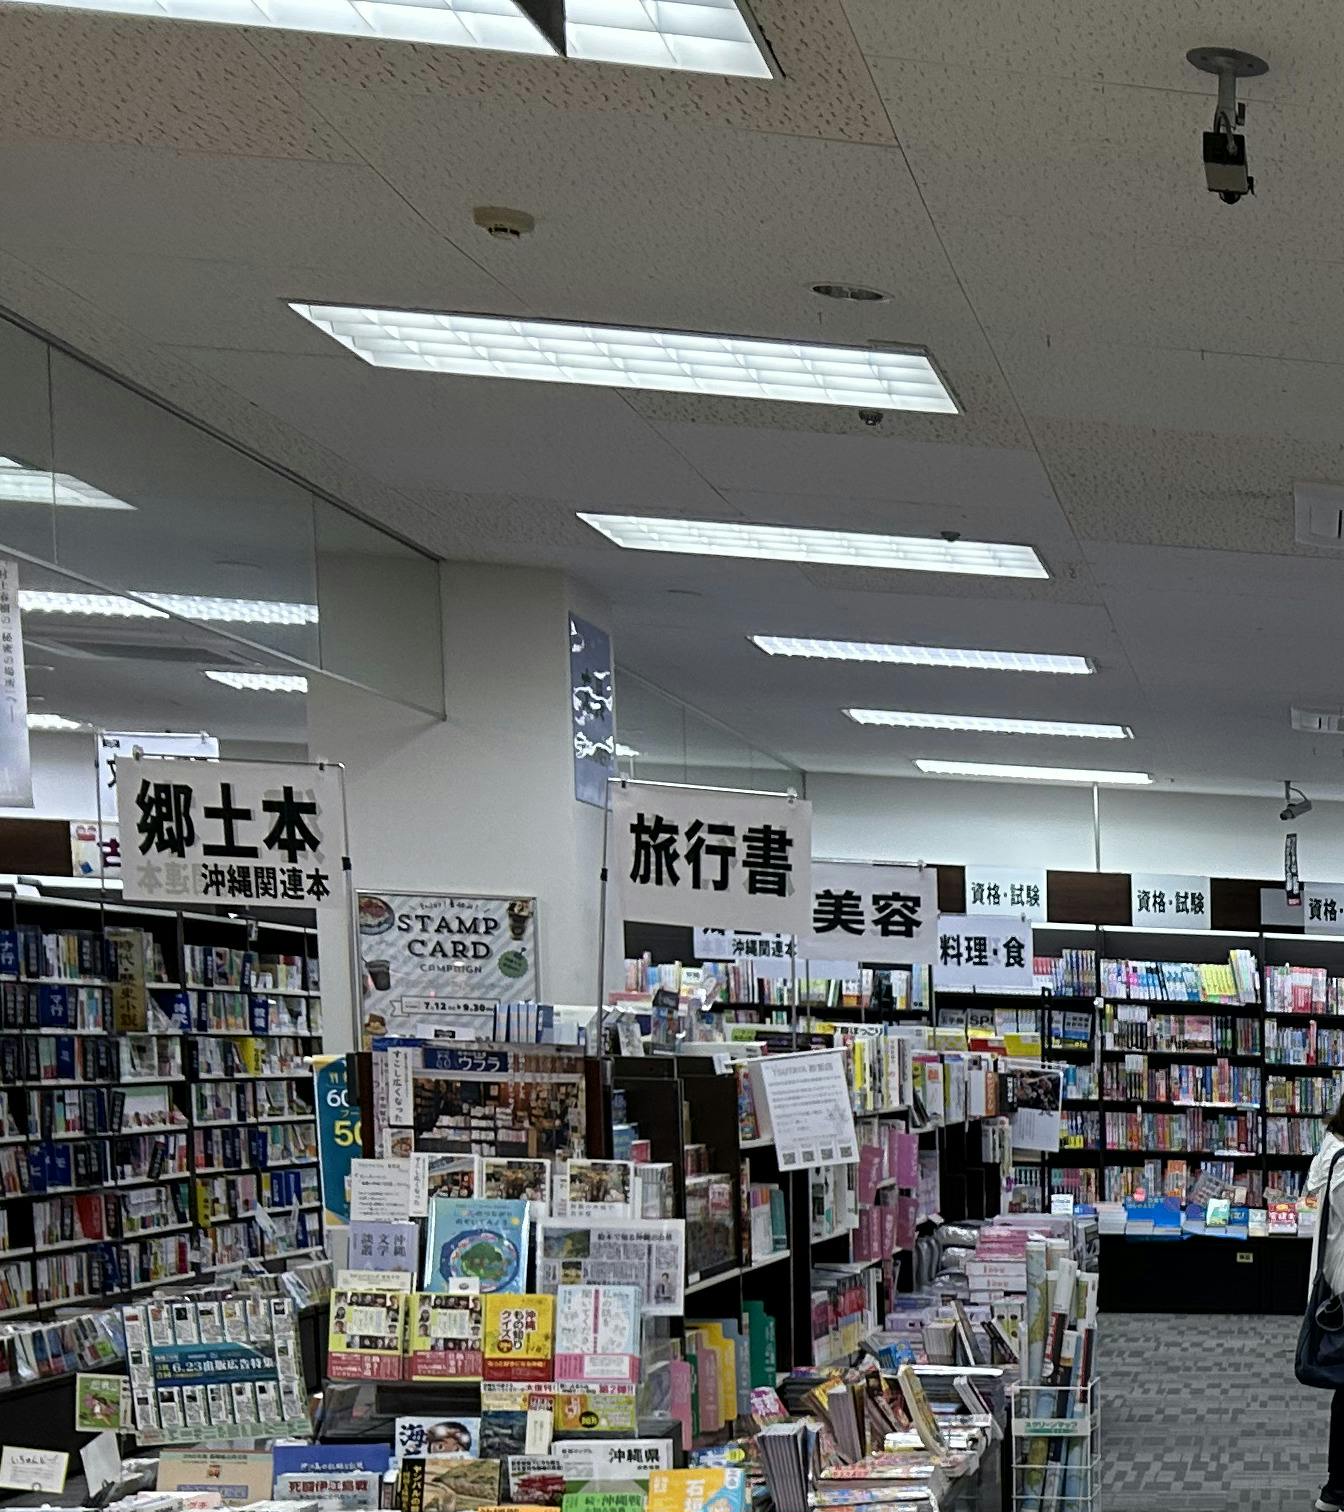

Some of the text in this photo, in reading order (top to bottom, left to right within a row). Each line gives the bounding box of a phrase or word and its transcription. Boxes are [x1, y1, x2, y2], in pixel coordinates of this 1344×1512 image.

[135, 779, 320, 864] 郷土本
[630, 813, 795, 898] 旅行書
[202, 863, 331, 902] 沖縄関連本
[972, 882, 1041, 907] 資格・試験
[812, 888, 923, 939] 美容
[1137, 890, 1205, 915] 資格・試験
[398, 914, 498, 935] STAMP
[408, 940, 490, 959] CARD
[732, 938, 797, 957] 沖縄関連本
[940, 934, 1025, 968] 料理・食
[420, 963, 482, 974] CAMPAIGN
[608, 1447, 660, 1463] 沖縄県
